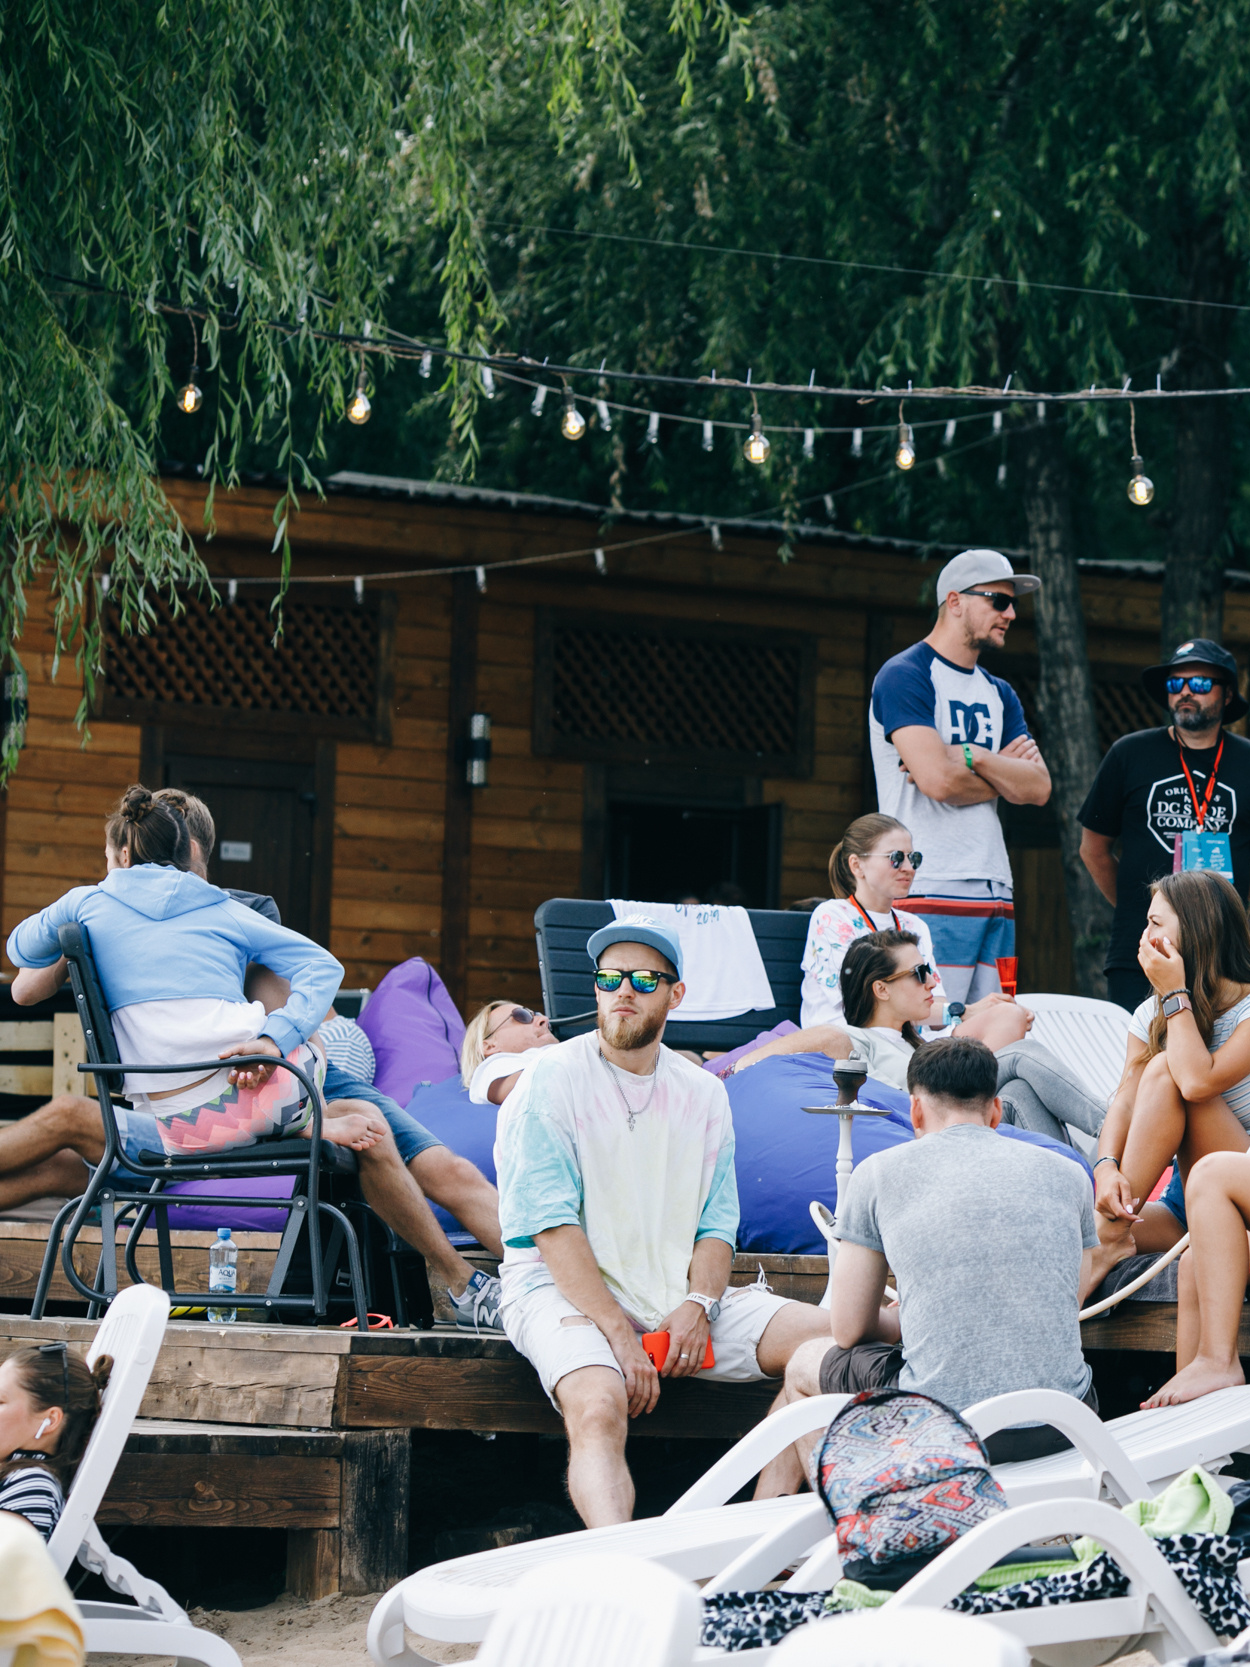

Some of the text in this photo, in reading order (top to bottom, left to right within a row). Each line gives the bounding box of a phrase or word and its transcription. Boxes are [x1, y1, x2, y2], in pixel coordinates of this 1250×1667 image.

[1157, 801, 1226, 819] DC SOE
[1157, 816, 1225, 831] COMPNY
[623, 913, 656, 926] NIKE
[218, 1269, 236, 1277] AQUA
